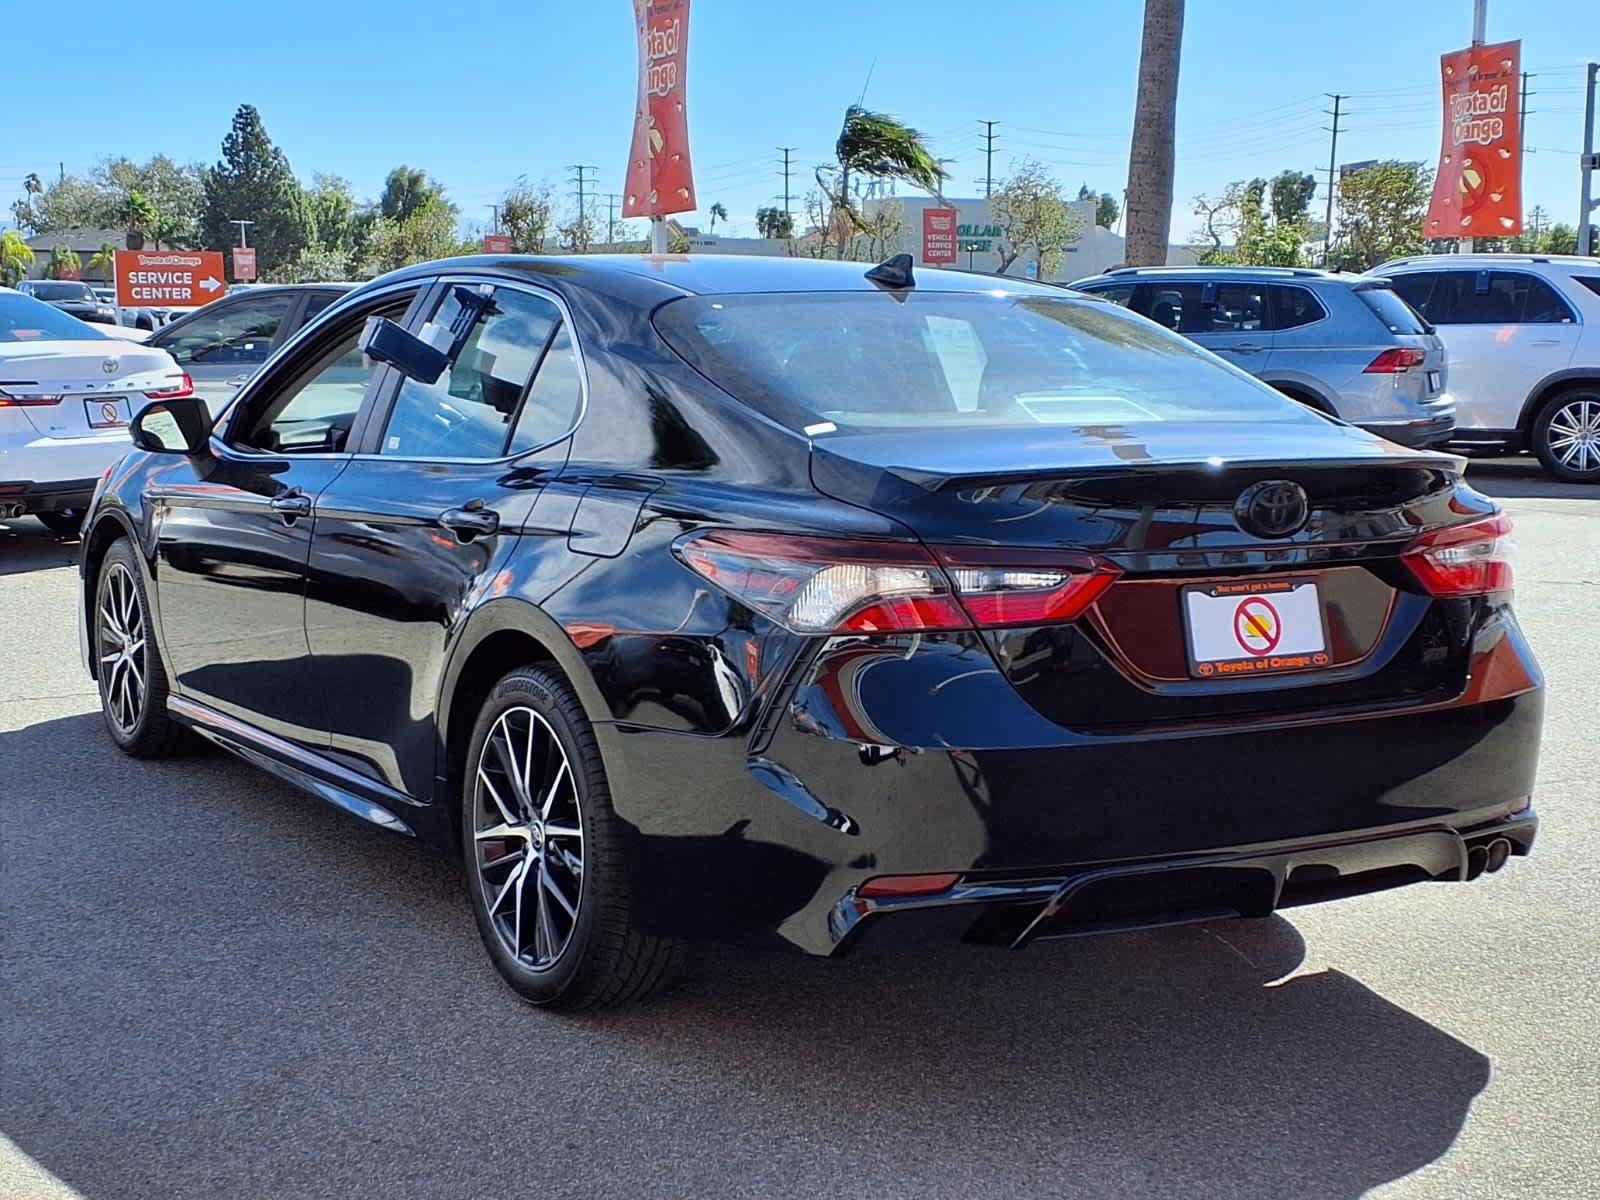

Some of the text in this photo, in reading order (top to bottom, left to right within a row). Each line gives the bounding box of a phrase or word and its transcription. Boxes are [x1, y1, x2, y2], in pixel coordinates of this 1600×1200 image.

[1489, 84, 1508, 113] of
[1453, 117, 1503, 146] Oange
[957, 224, 1002, 237] OLLAR
[137, 255, 164, 266] Toyota
[128, 271, 193, 285] SERVICE
[131, 287, 192, 300] CENTER
[1216, 656, 1312, 673] Toyota of Orange
